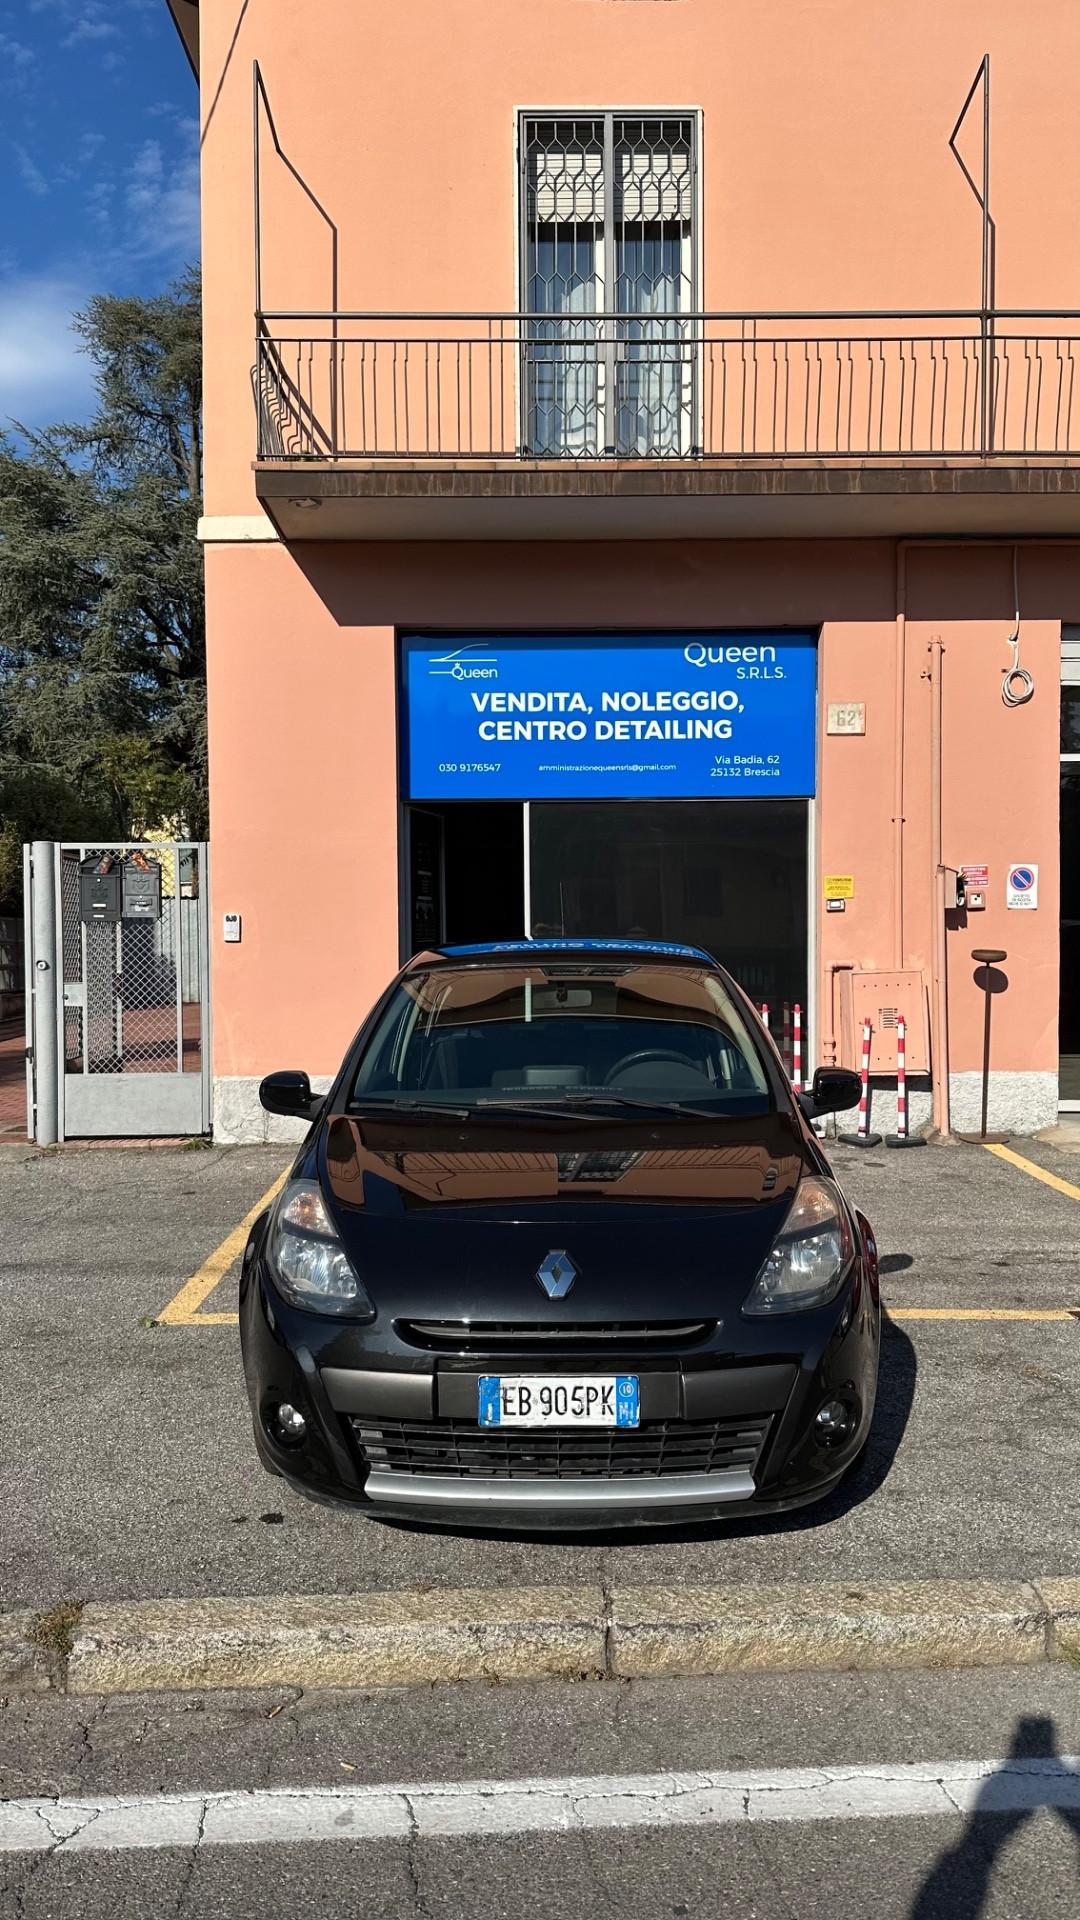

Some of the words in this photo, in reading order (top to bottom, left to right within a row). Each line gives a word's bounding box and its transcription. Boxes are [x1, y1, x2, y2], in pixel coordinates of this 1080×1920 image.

[684, 642, 777, 667] Queen
[451, 665, 498, 680] Queen
[736, 666, 787, 679] S.R.L.S.
[471, 692, 593, 715] VENDITA,
[601, 690, 745, 713] NOLEGGIO,
[478, 720, 587, 741] CENTRO
[595, 719, 733, 741] DETAILING
[438, 763, 457, 772] 030
[459, 763, 501, 772] 9176547
[715, 755, 731, 764] Via
[733, 755, 765, 766] Badia,
[767, 755, 780, 764] 62
[710, 767, 741, 777] 25132
[744, 767, 780, 776] Brescia
